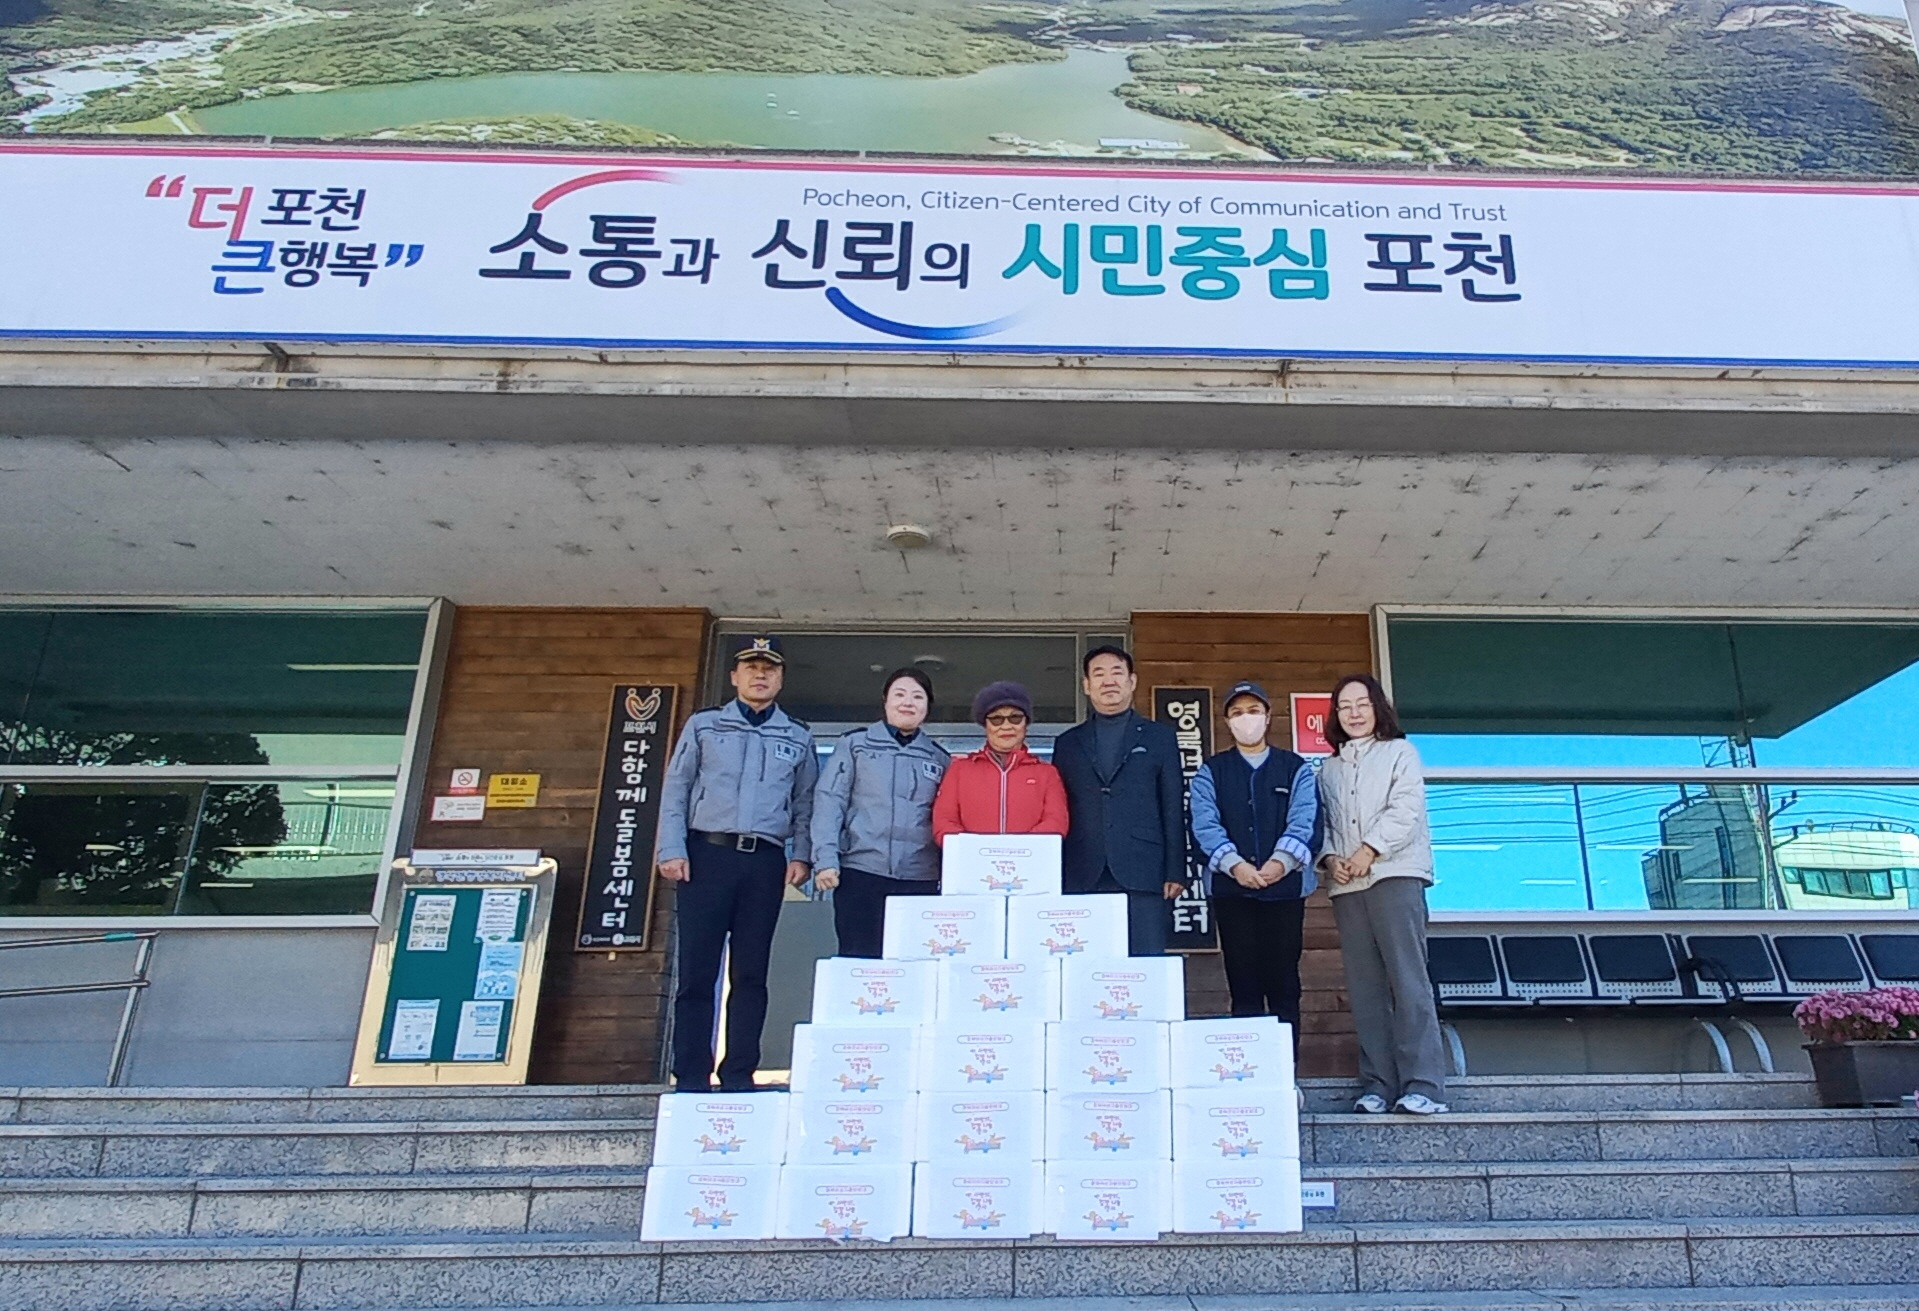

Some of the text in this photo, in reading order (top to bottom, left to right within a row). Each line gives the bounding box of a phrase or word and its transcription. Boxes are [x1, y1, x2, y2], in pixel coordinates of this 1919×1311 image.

[261, 187, 367, 233] 포천
[803, 188, 1507, 222] Pocheon, Citizen-Centered City of Communication and Trust
[478, 212, 1523, 303] 소통과 신뢰의 시민중심 포천
